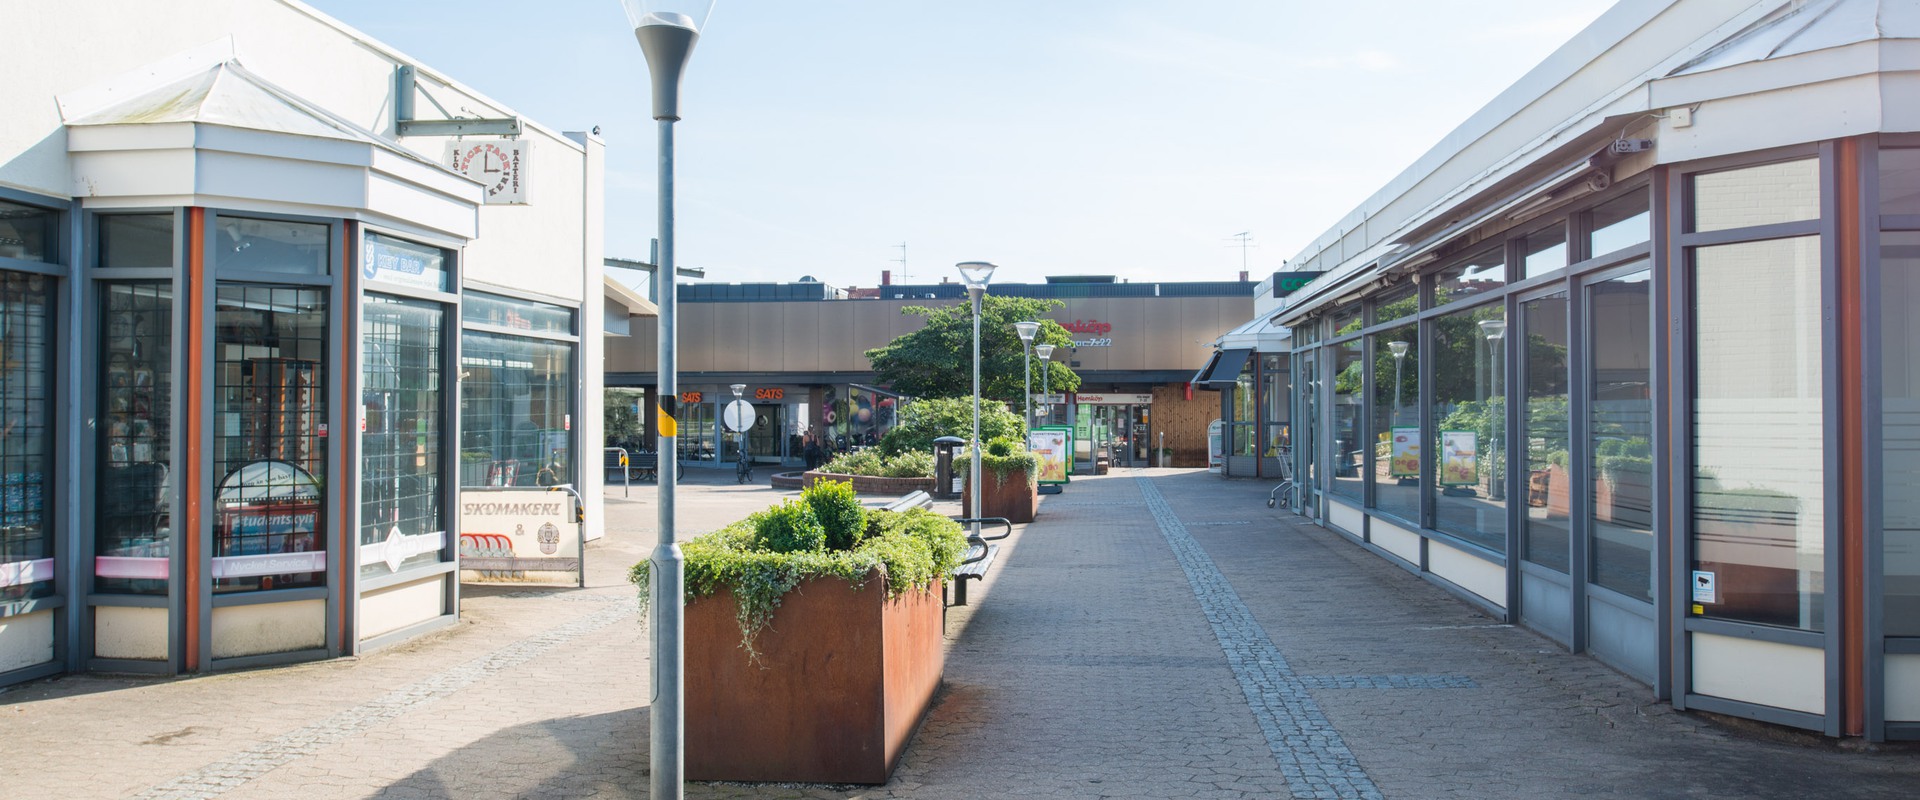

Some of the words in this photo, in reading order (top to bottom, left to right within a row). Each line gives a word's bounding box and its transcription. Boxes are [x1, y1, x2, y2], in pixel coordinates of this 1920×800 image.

[461, 145, 483, 171] TICK
[486, 143, 511, 170] TACK
[377, 253, 399, 269] KEY
[681, 392, 702, 403] SATS
[755, 388, 784, 400] SATS
[463, 503, 561, 516] SKOMAKERI
[515, 524, 525, 536] &
[230, 560, 266, 572] Nyckel
[269, 558, 308, 570] Service
